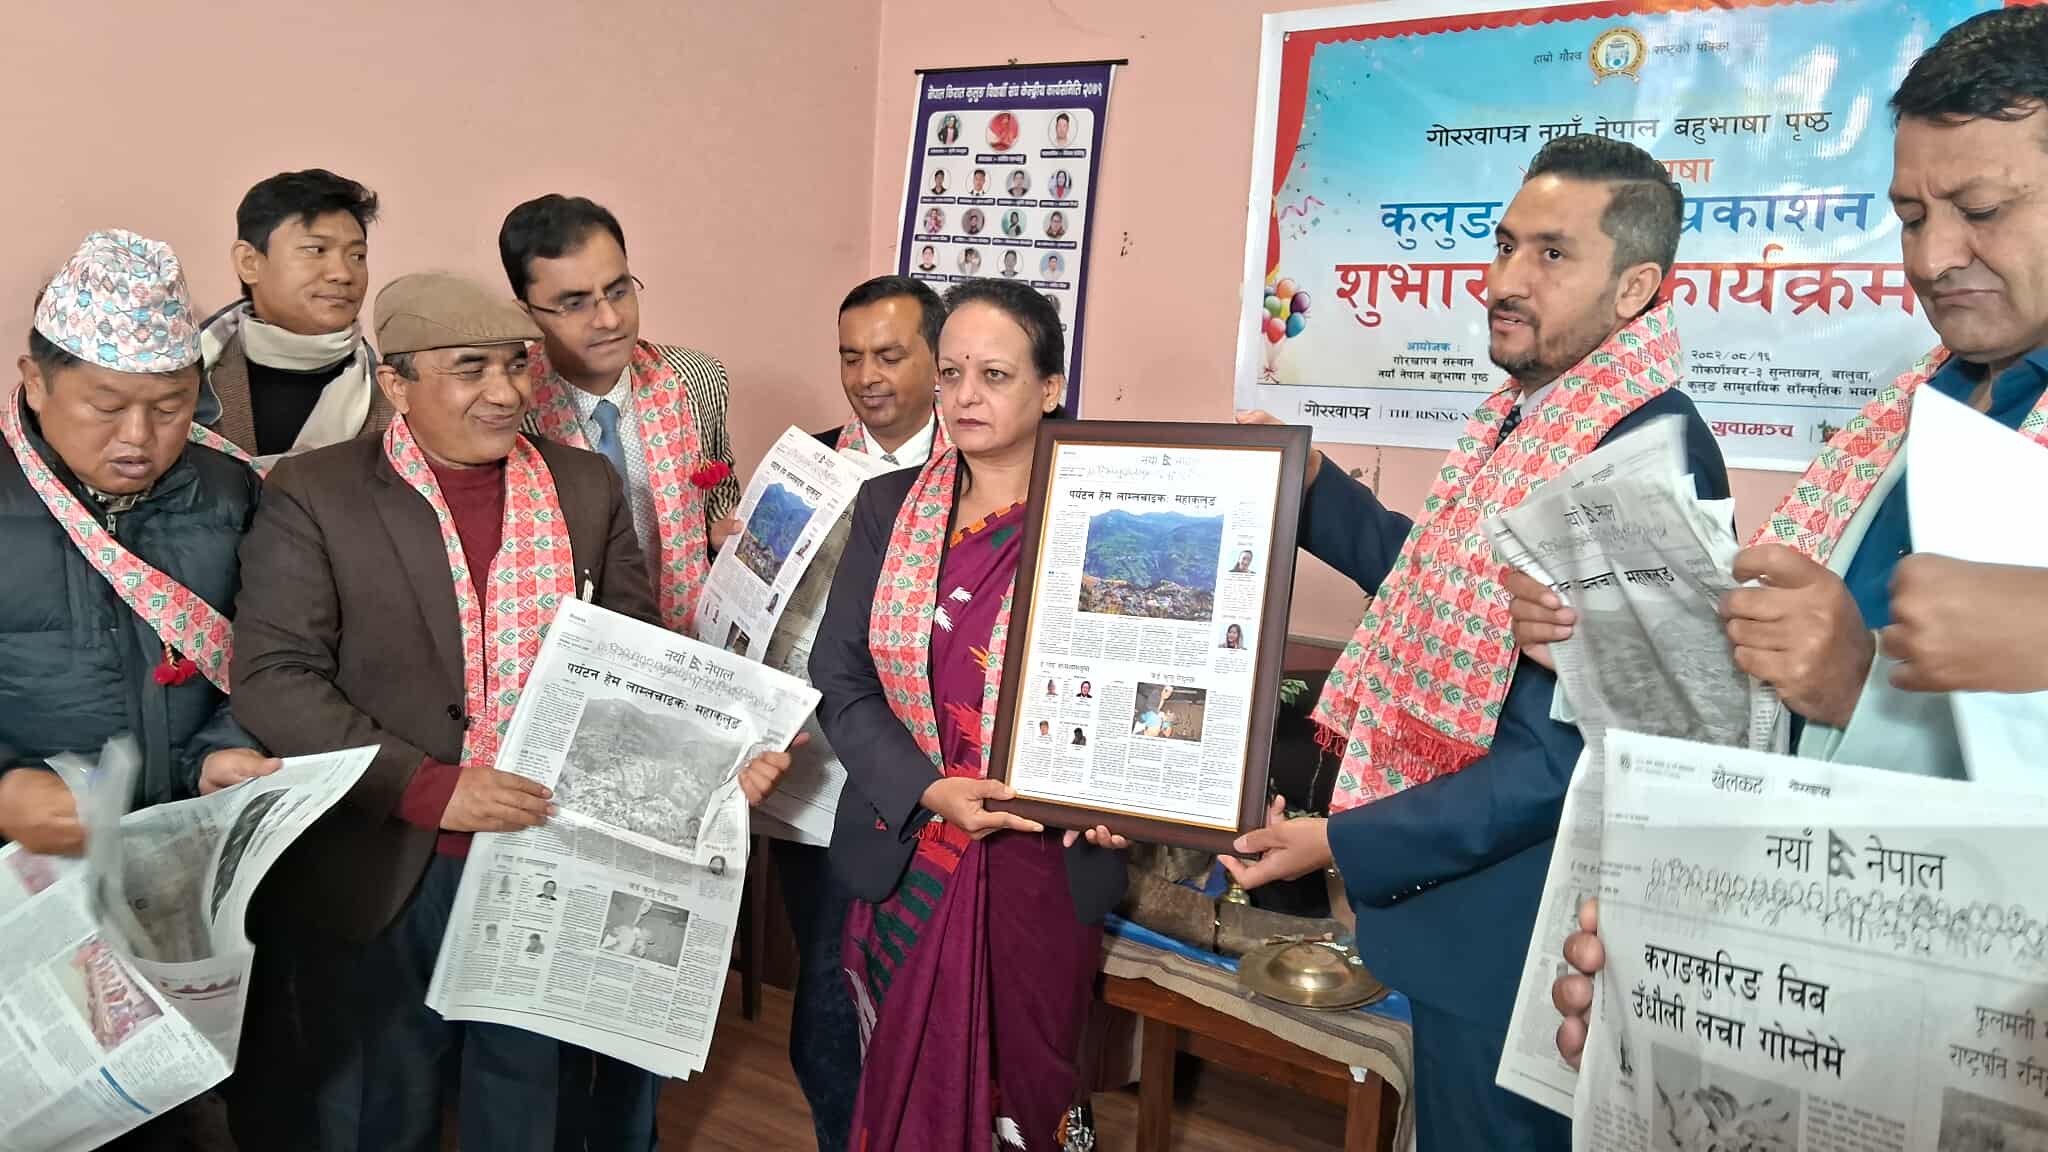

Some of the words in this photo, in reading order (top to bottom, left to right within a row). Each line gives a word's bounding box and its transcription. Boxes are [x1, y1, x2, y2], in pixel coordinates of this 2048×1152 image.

[1426, 124, 1531, 147] गोरखापत्र
[1595, 117, 1660, 139] नेपाल
[1674, 114, 1771, 145] बहुभाषा
[1785, 111, 1833, 143] पृष्ठ
[1381, 202, 1503, 250] कुलुङ
[1393, 354, 1437, 366] गोरखापत्र
[1400, 368, 1424, 380] नेपाल
[1430, 371, 1466, 384] बहुभाषा
[1472, 372, 1489, 385] पृष्ठ
[1849, 387, 1877, 398] भवन
[1304, 400, 1371, 420] गोरखापत्र
[1388, 408, 1411, 419] THE
[1415, 410, 1459, 421] RISING
[1711, 421, 1794, 438] युवामञ्च
[567, 661, 600, 682] पर्यटन
[704, 659, 736, 682] नेपाल
[1766, 827, 1814, 873] नयाँ
[1865, 834, 1948, 891] नेपाल
[1644, 943, 1764, 1001] कराङकुरिङ
[1695, 1009, 1746, 1050] लचा
[1759, 1020, 1846, 1080] गोम्तेमे
